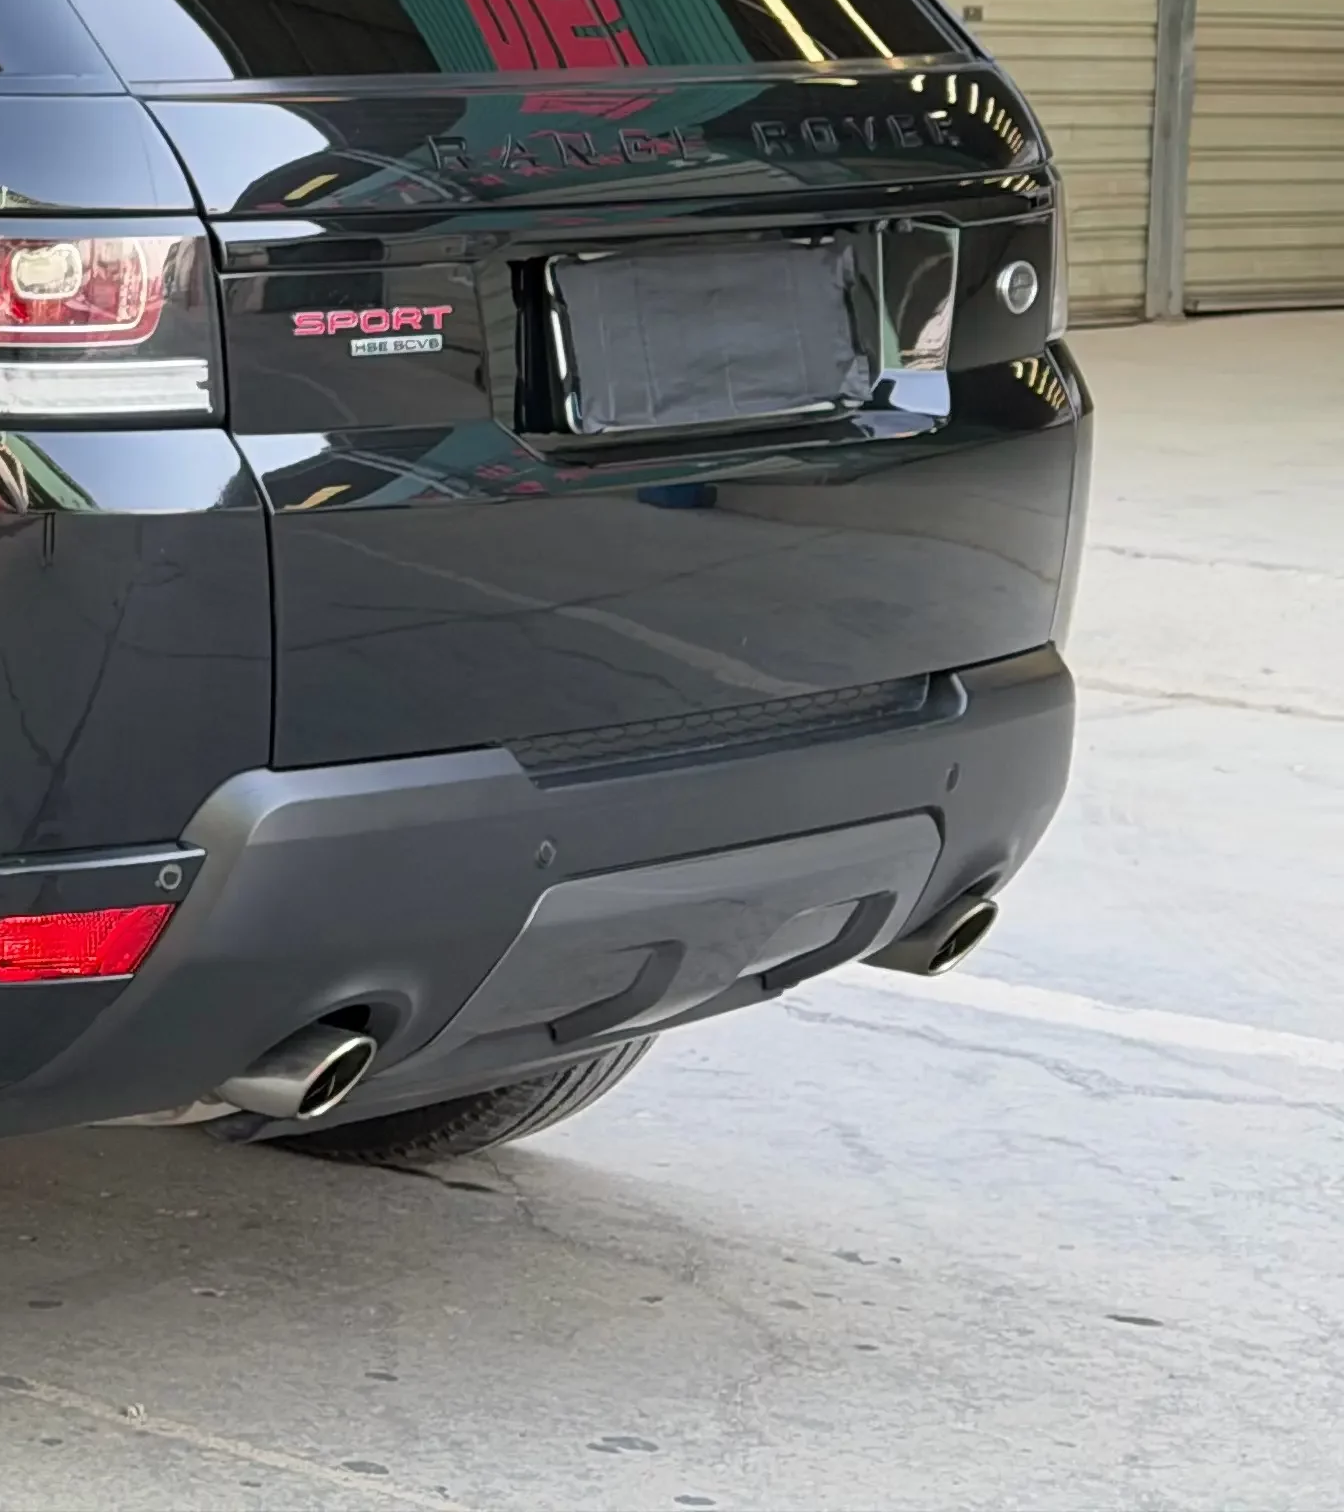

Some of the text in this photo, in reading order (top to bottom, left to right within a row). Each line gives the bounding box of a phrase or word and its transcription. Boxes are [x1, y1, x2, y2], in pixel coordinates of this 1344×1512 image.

[427, 109, 960, 170] RANGE ROVER
[292, 304, 453, 336] SPORT
